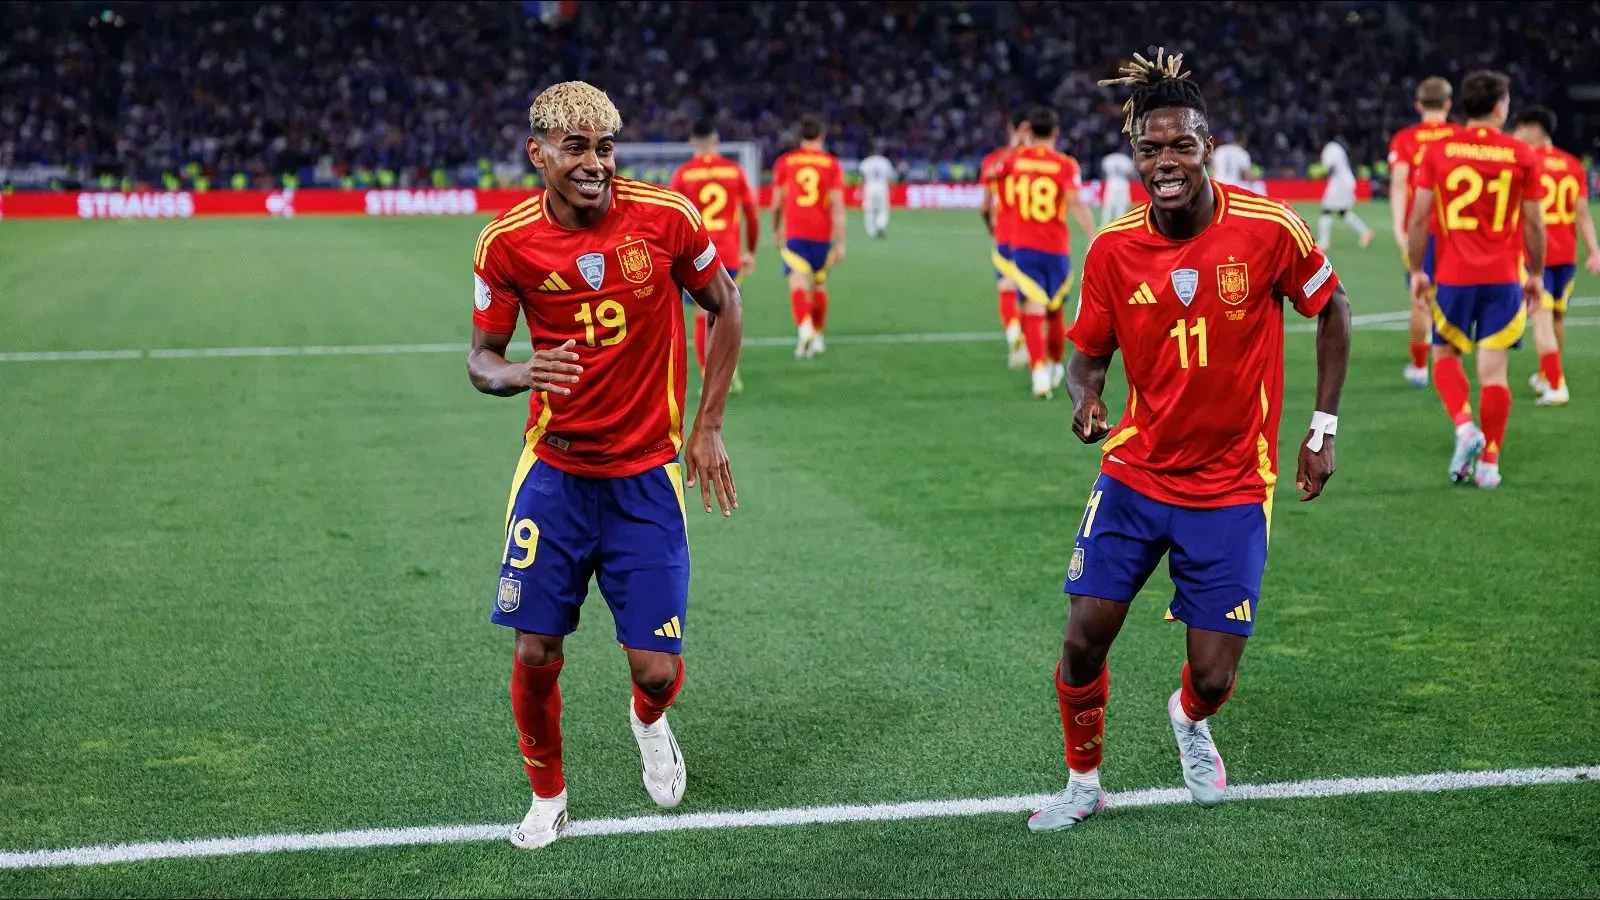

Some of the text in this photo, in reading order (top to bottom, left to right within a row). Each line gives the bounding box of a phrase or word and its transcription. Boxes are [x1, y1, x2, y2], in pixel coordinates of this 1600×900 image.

[77, 192, 195, 219] STRAUSS
[365, 189, 478, 216] STRAUSS
[697, 182, 728, 232] 2
[795, 166, 820, 207] 3
[1015, 174, 1058, 223] 18
[1445, 165, 1514, 232] 21
[1539, 174, 1580, 225] 20
[574, 299, 627, 348] 19
[1170, 317, 1208, 369] 11
[502, 514, 540, 569] 19
